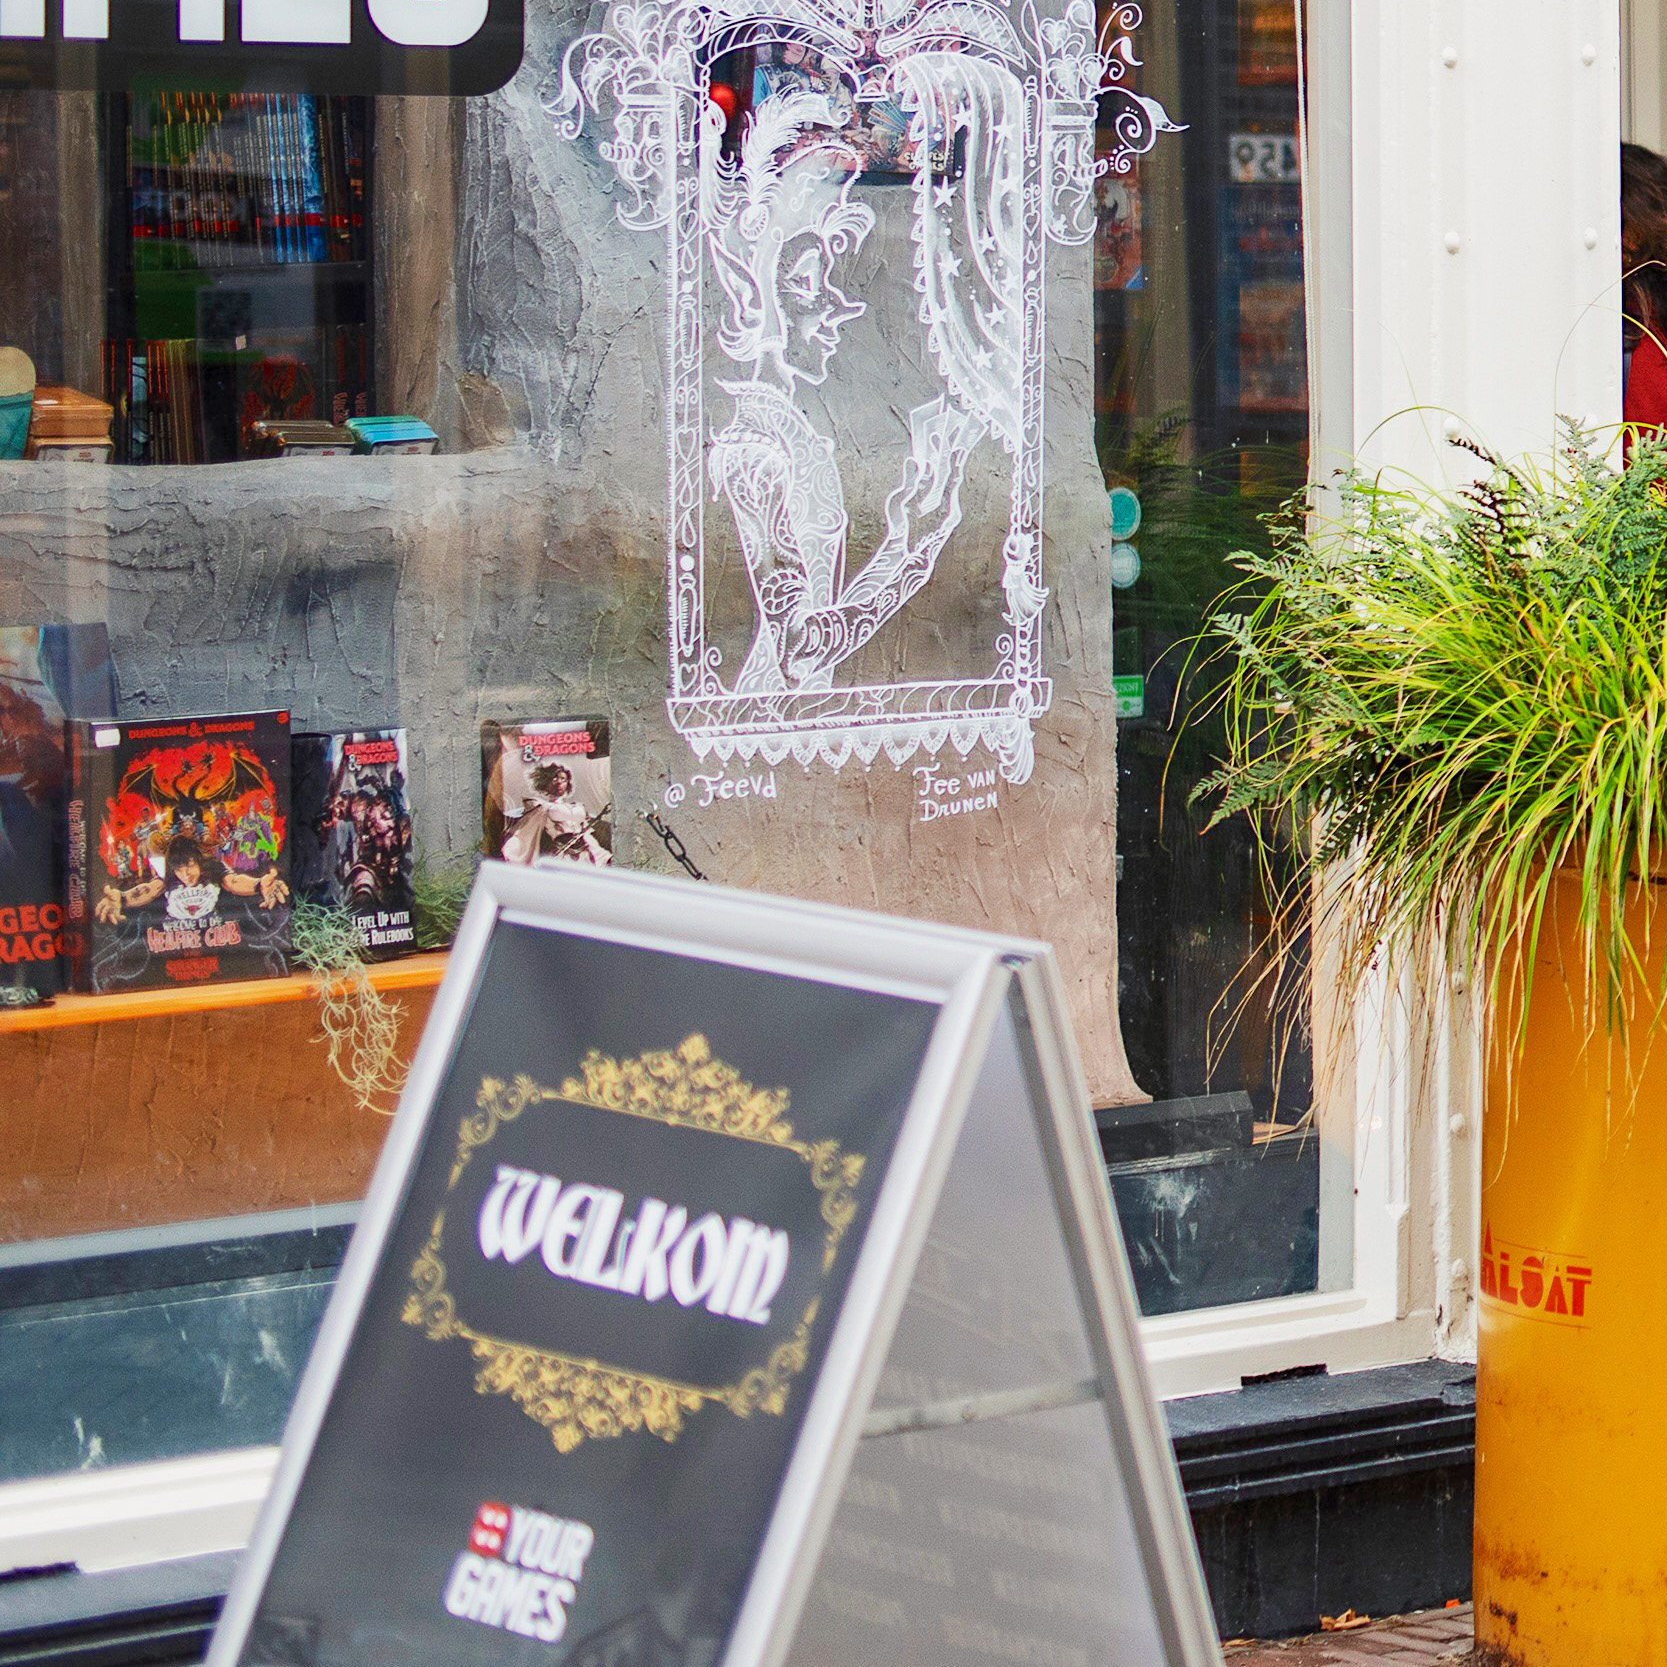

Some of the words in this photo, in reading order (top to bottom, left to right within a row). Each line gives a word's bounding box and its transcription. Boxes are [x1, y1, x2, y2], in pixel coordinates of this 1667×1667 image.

[128, 728, 186, 739] DUNGEONS
[189, 722, 203, 738] &
[204, 721, 255, 733] DRAGONS
[517, 731, 591, 747] DUNGEONS
[344, 740, 394, 755] DUNGEONS
[523, 744, 541, 762] &
[534, 741, 596, 756] DRAGONS
[348, 754, 362, 771] &
[355, 751, 398, 765] DRAGONS
[912, 762, 961, 796] Fee
[204, 921, 242, 947] CLUB
[371, 927, 415, 946] RULEBOOKS
[477, 1165, 789, 1325] WELKOM
[506, 1503, 595, 1582] YOUR
[443, 1551, 577, 1645] GAMES
